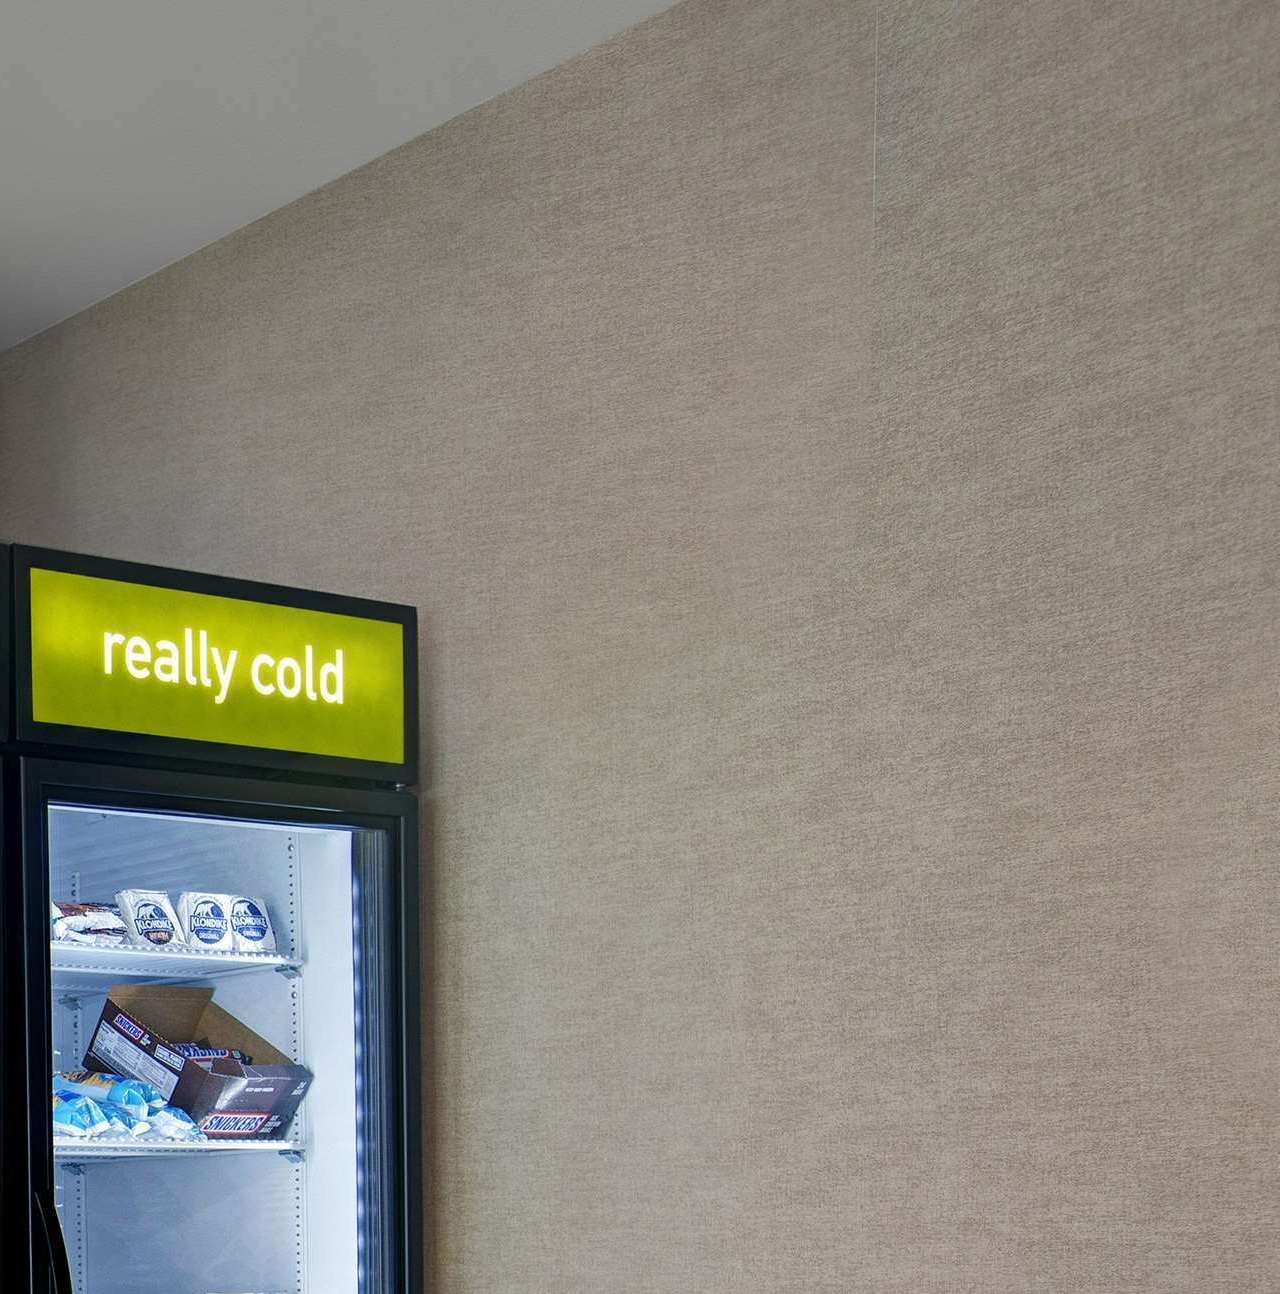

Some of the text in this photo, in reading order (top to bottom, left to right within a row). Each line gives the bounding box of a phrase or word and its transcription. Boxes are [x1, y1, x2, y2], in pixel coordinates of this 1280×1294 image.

[102, 627, 346, 706] really cold
[191, 915, 228, 931] KLONDIKE
[202, 1115, 267, 1132] SNICKERS
